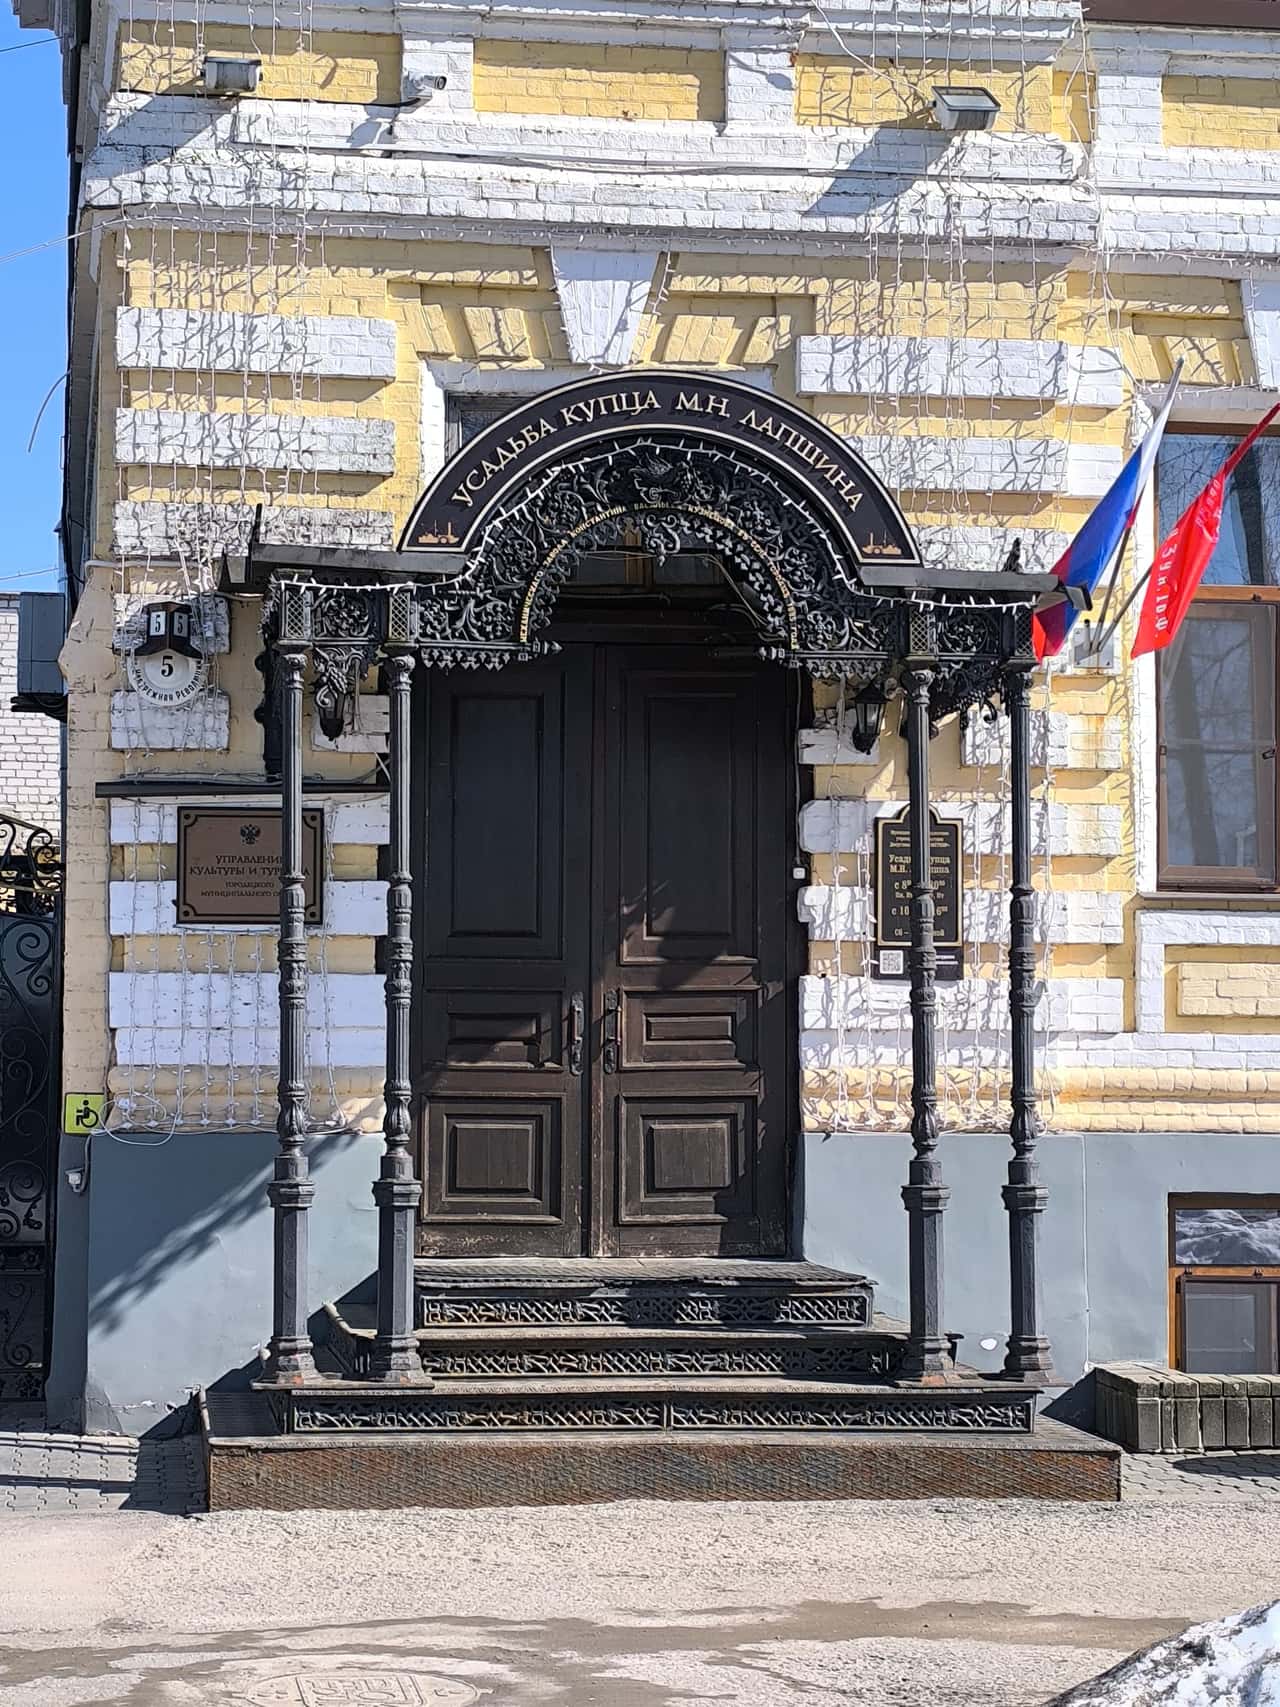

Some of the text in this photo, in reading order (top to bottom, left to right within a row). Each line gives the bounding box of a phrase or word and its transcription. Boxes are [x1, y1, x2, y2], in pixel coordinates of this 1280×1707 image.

[452, 418, 557, 507] УСАДЬБА
[561, 390, 662, 426] КУПЦА
[739, 409, 864, 512] ЛАПШИНА
[155, 614, 162, 633] 5
[177, 614, 184, 633] 5
[161, 655, 174, 677] 5
[216, 855, 282, 864] УПРАВЛЕНИ
[189, 866, 246, 876] КУЛЬТУРЫ
[248, 866, 258, 875] И
